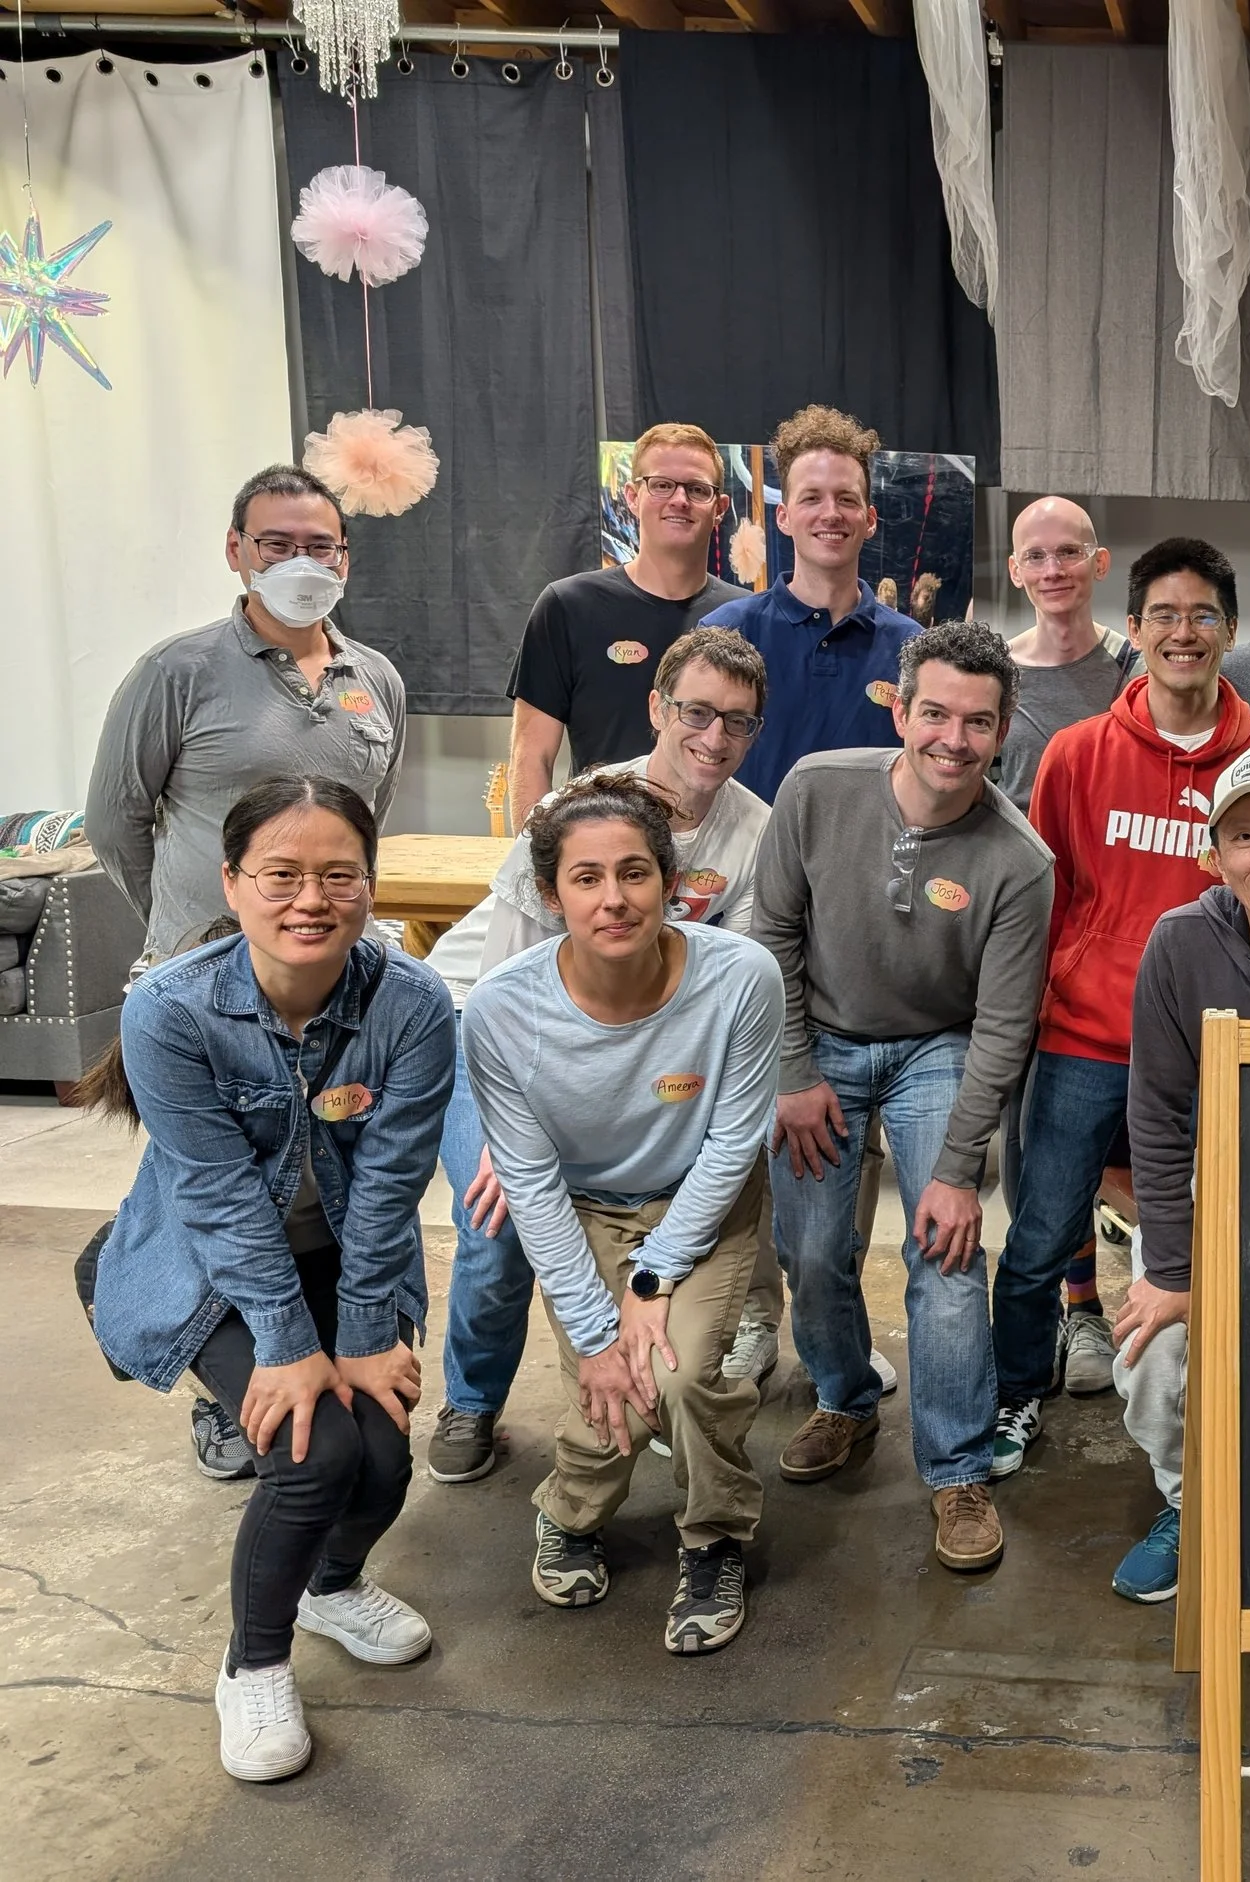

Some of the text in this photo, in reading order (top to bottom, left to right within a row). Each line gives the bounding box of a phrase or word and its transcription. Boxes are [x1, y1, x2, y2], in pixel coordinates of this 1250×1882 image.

[296, 594, 313, 602] 3M
[614, 645, 642, 662] Ryan
[343, 692, 370, 710] Ayres
[1105, 809, 1212, 859] PUMA
[688, 870, 720, 889] Jeff
[930, 882, 962, 903] Josh
[656, 1079, 700, 1094] Ameera
[322, 1091, 366, 1112] Hailey
